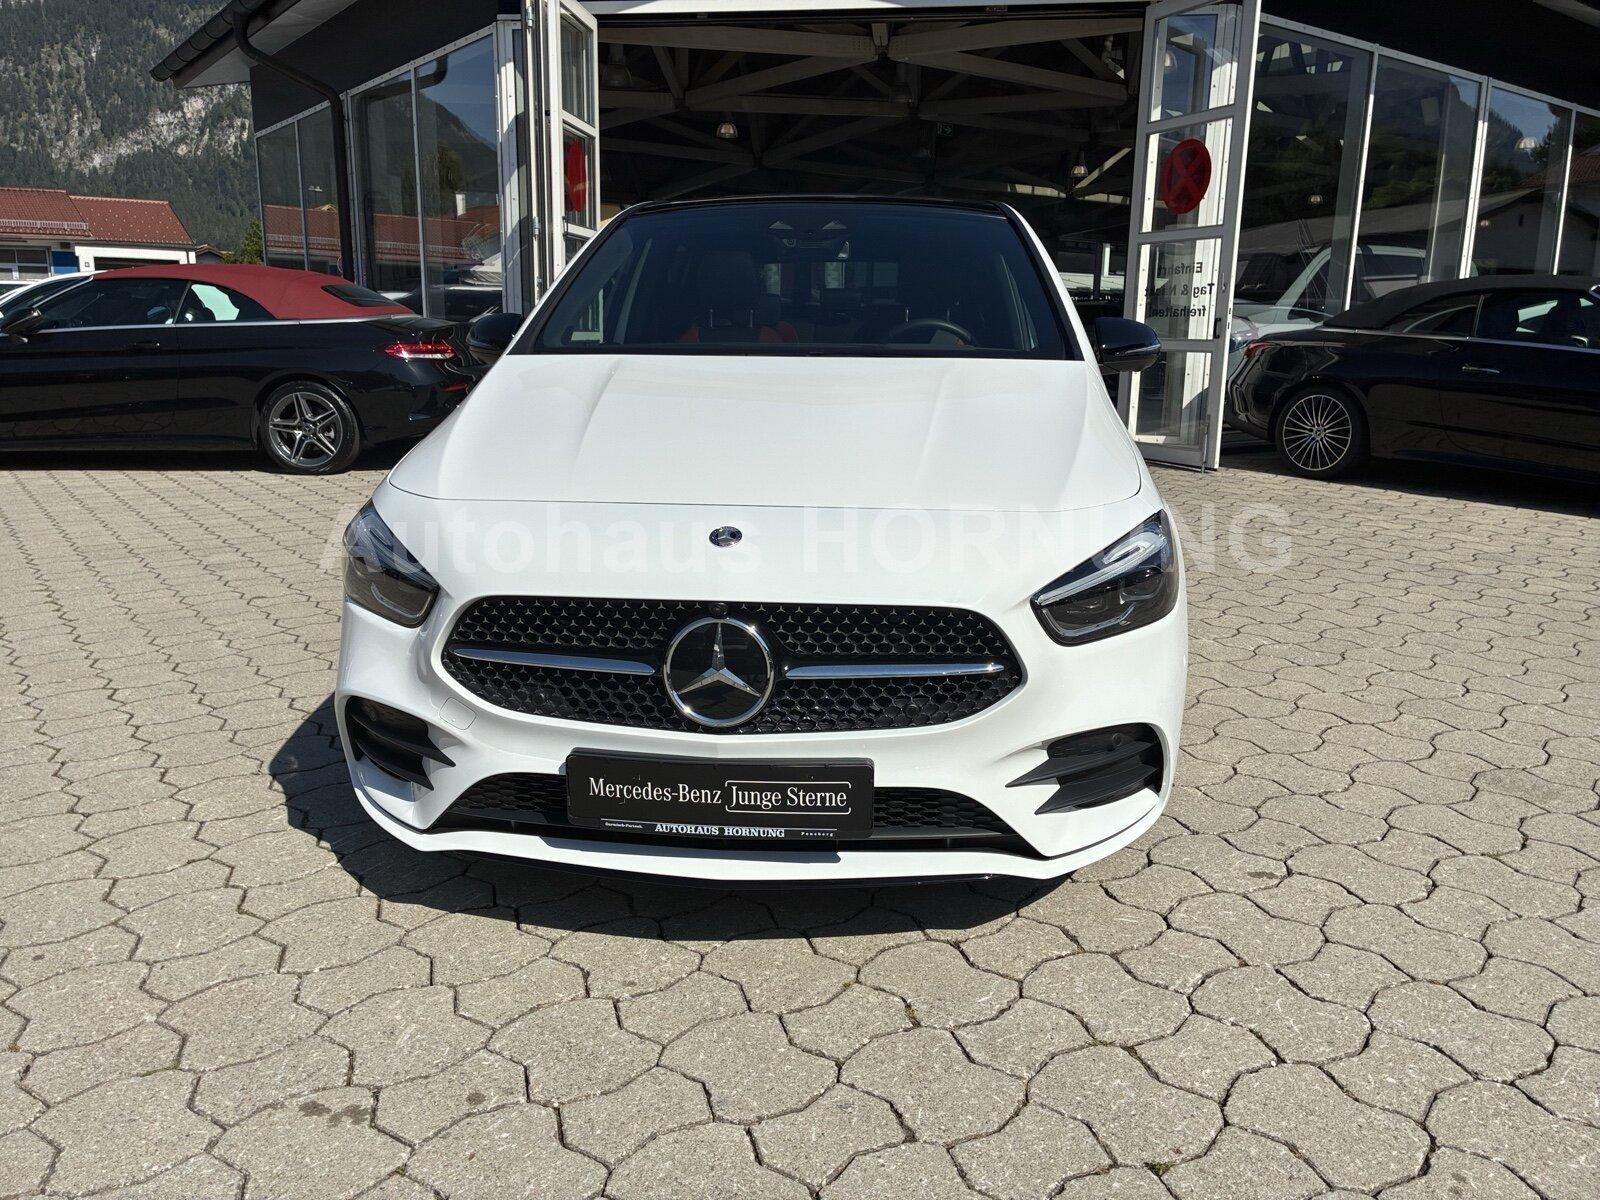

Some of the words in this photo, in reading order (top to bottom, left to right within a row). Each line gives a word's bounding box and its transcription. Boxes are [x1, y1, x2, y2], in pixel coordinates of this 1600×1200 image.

[589, 777, 722, 804] Mercedes-Benz
[730, 785, 782, 810] Junge
[786, 786, 848, 807] Sterne
[655, 823, 719, 836] AUTOHAUS
[723, 826, 786, 838] HORNUNG
